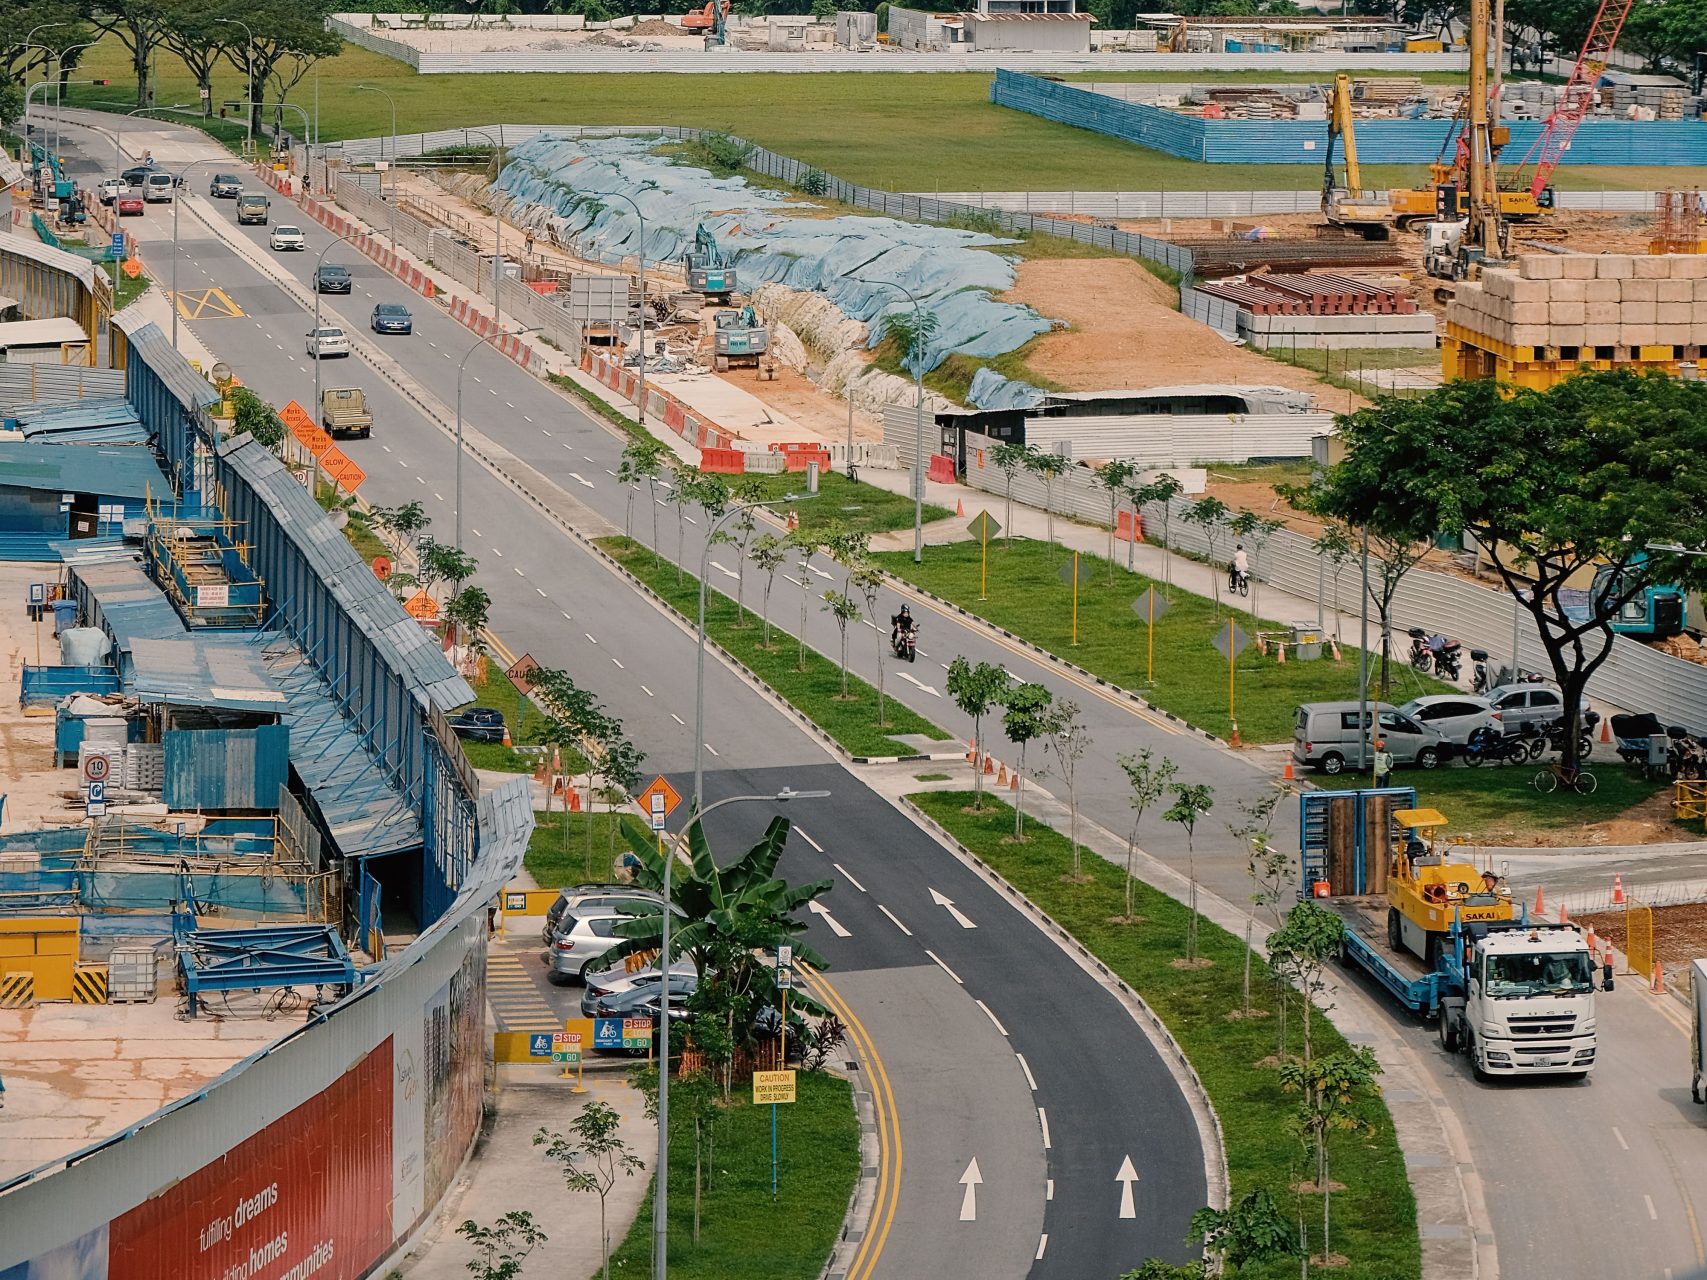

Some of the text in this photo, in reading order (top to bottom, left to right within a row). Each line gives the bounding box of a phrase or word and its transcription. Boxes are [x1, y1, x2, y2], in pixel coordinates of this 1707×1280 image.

[325, 458, 344, 466] SLOW
[91, 761, 103, 771] 10
[1465, 912, 1495, 920] SAKAI
[634, 1020, 651, 1028] STOP
[562, 1034, 581, 1042] STOP
[636, 1039, 647, 1047] GO
[566, 1053, 577, 1062] GO
[759, 1073, 790, 1082] CAUTION
[755, 1085, 767, 1093] WORK
[773, 1083, 794, 1092] PROGRESS
[760, 1092, 789, 1101] DRIVE SLOWLY
[199, 1182, 278, 1253] fulfilling dreams
[249, 1231, 288, 1276] homes
[280, 1238, 334, 1280] mmunities
